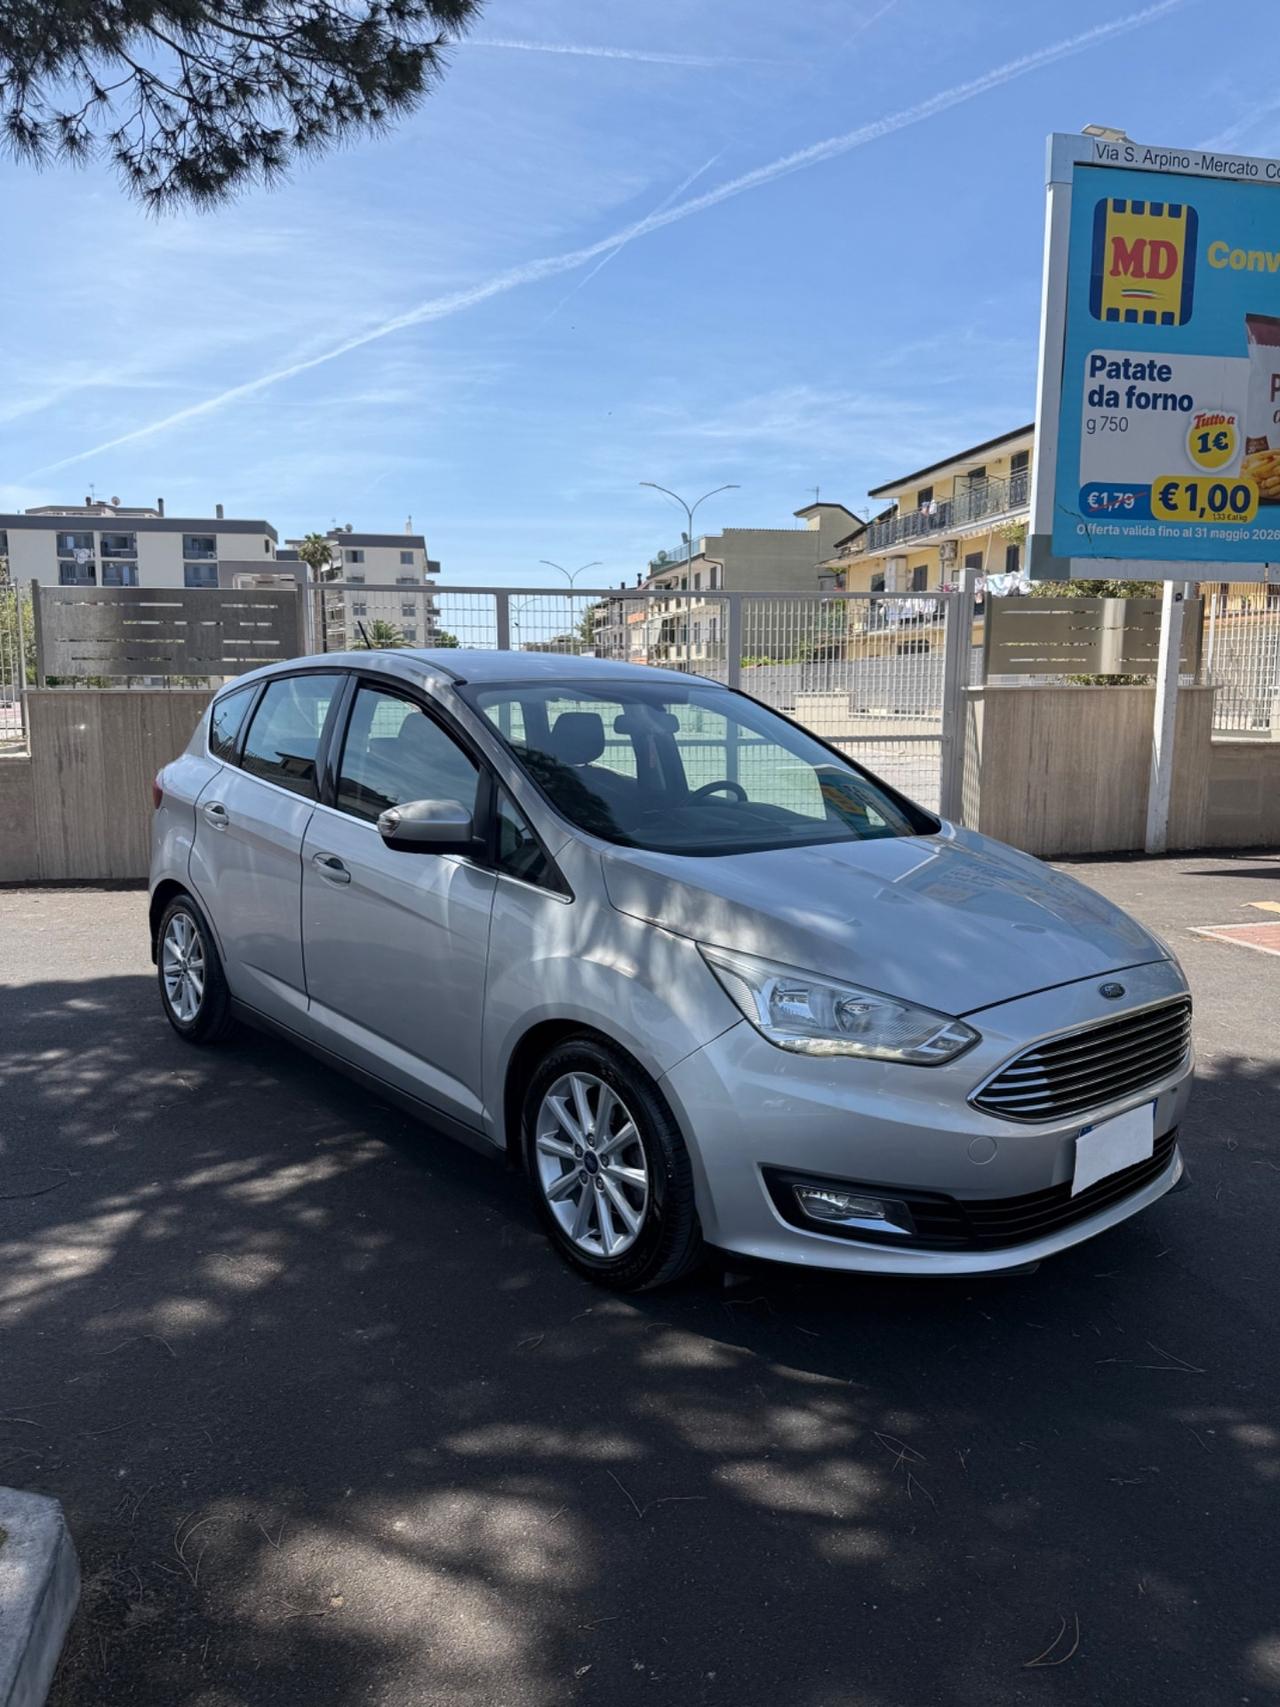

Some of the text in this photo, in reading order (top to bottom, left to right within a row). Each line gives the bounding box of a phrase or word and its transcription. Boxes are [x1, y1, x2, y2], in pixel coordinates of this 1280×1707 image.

[1095, 143, 1119, 160] Via
[1124, 146, 1138, 163] S.
[1142, 149, 1190, 169] Arpino
[1109, 236, 1179, 280] MD
[1207, 240, 1280, 273] Conv
[1089, 354, 1173, 383] Patate
[1088, 384, 1194, 412] da forno
[1086, 416, 1129, 435] g 750
[1193, 412, 1236, 430] Tutto a
[1158, 482, 1252, 518] €1,00
[1076, 523, 1120, 536] Offerta
[1122, 524, 1156, 537] valida
[1158, 525, 1180, 537] fino
[1182, 527, 1192, 537] al
[1194, 527, 1207, 538] 31
[1210, 528, 1250, 542] maggio
